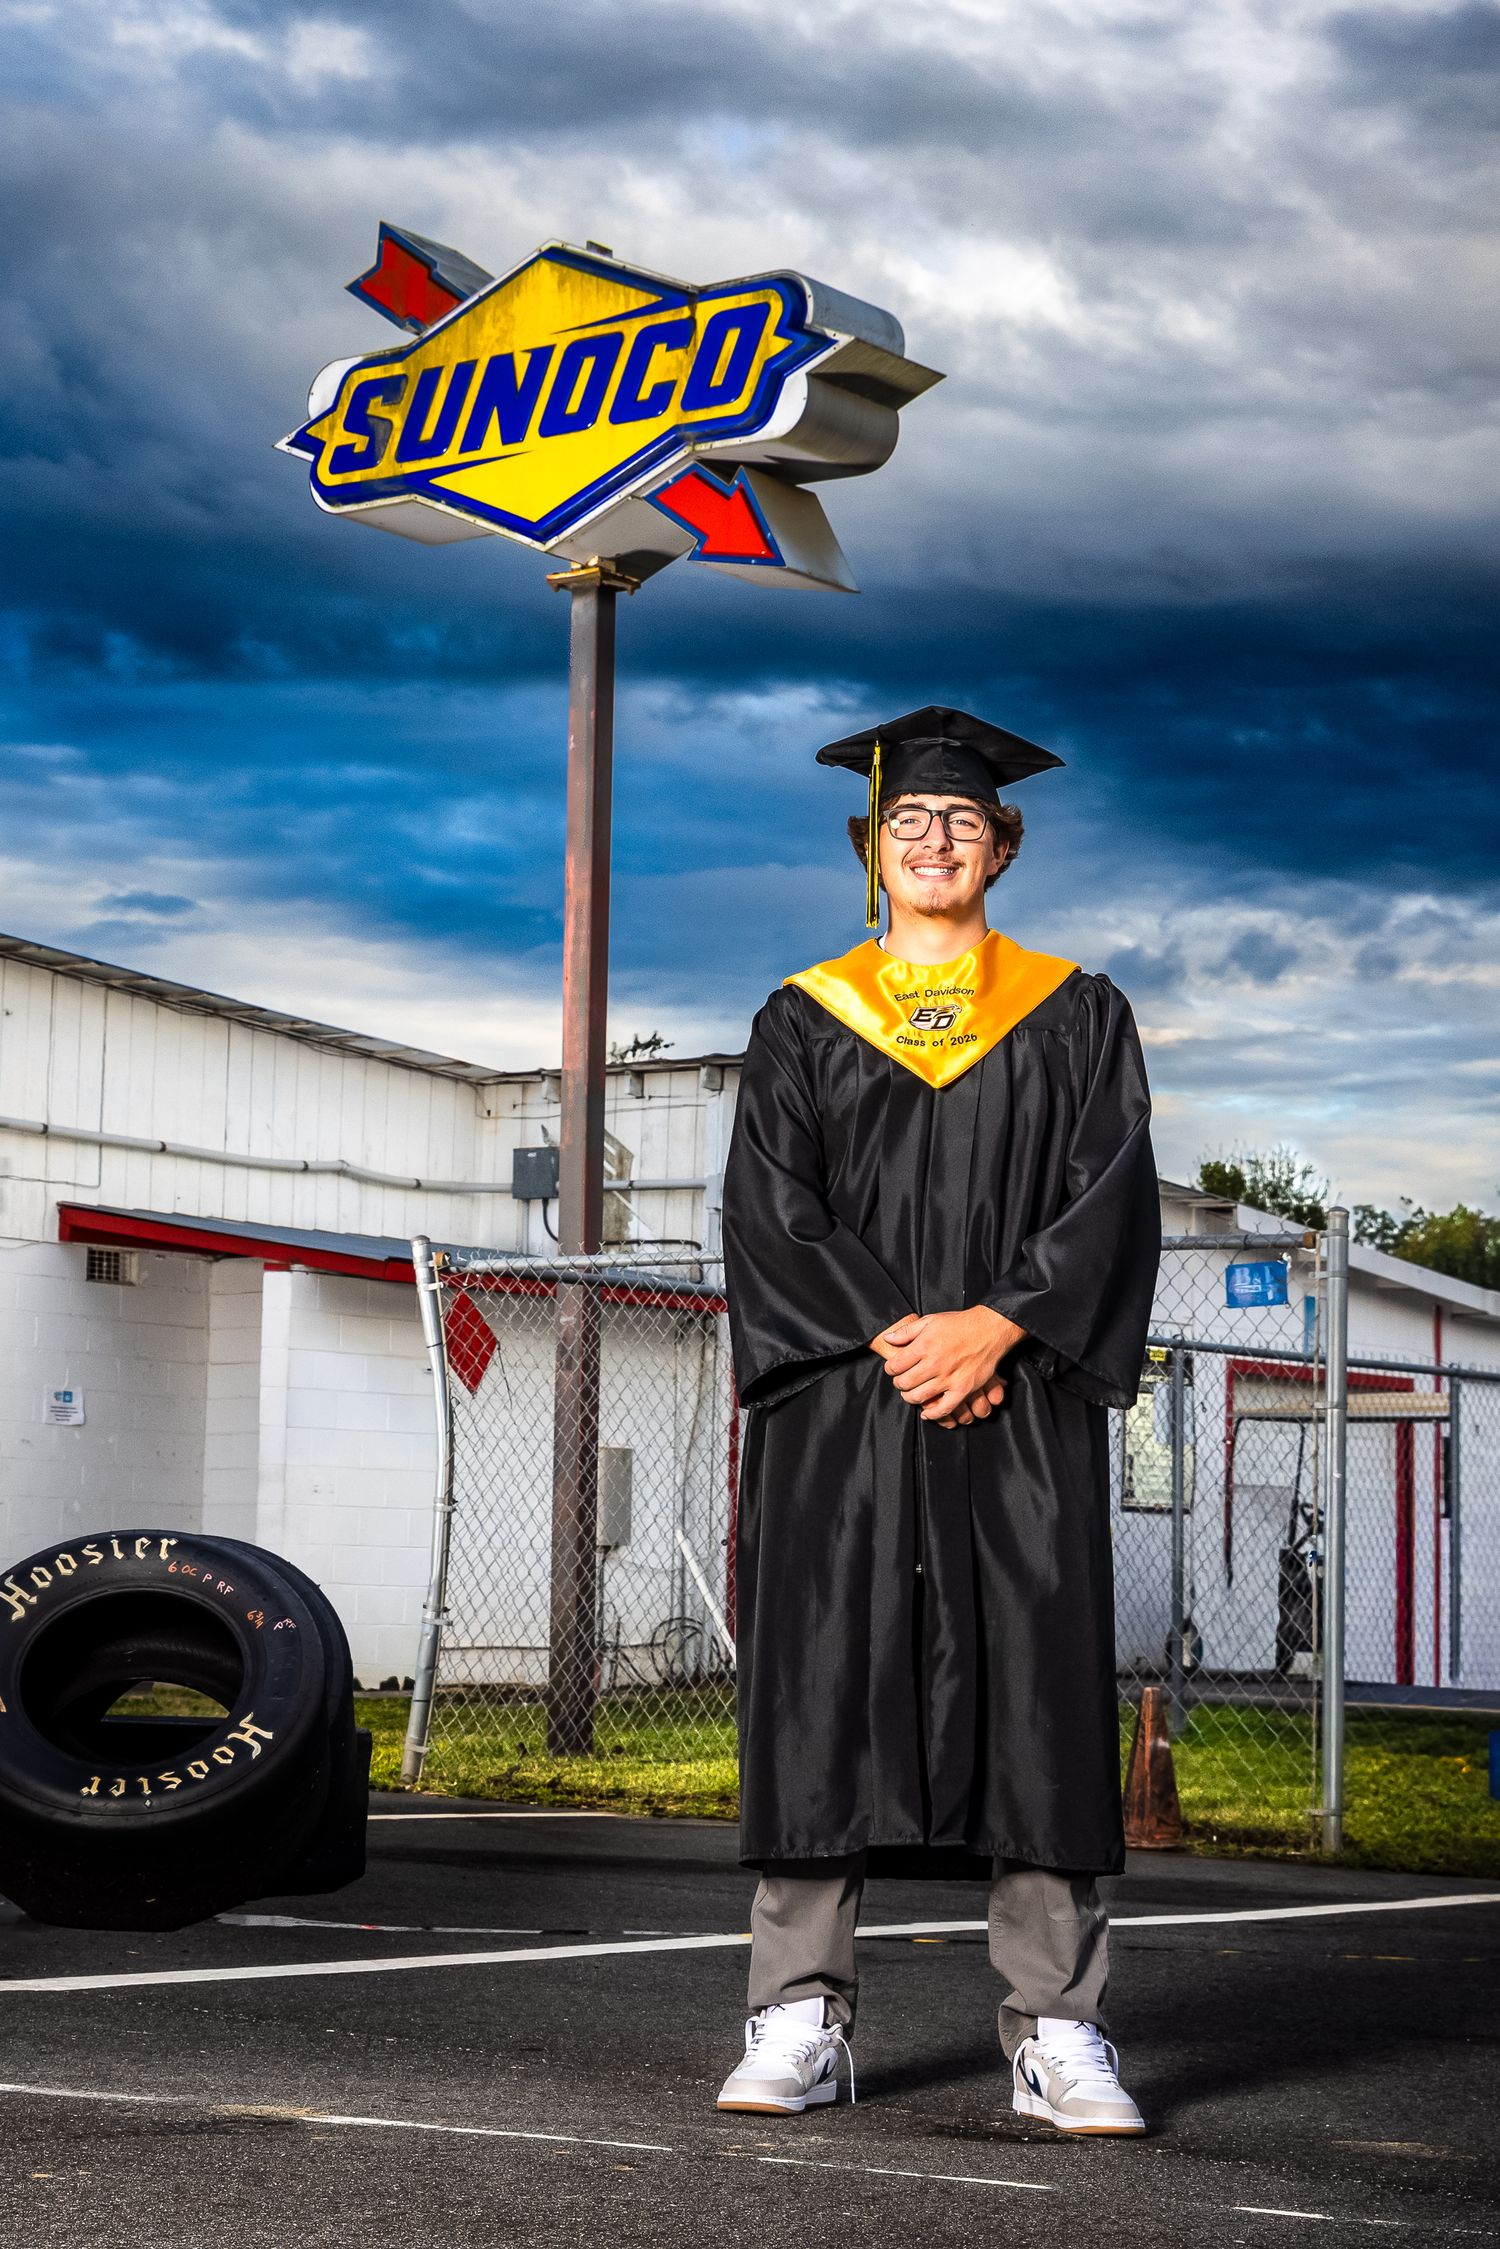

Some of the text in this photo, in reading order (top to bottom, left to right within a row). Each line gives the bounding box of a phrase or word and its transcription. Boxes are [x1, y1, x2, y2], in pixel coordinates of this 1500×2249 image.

[328, 302, 770, 475] SUNOCO
[894, 986, 975, 1001] East Davidson
[896, 1035, 926, 1047] Class
[932, 1038, 944, 1047] of
[0, 1534, 179, 1622] Hoosier
[79, 1711, 274, 1808] Hoosier
